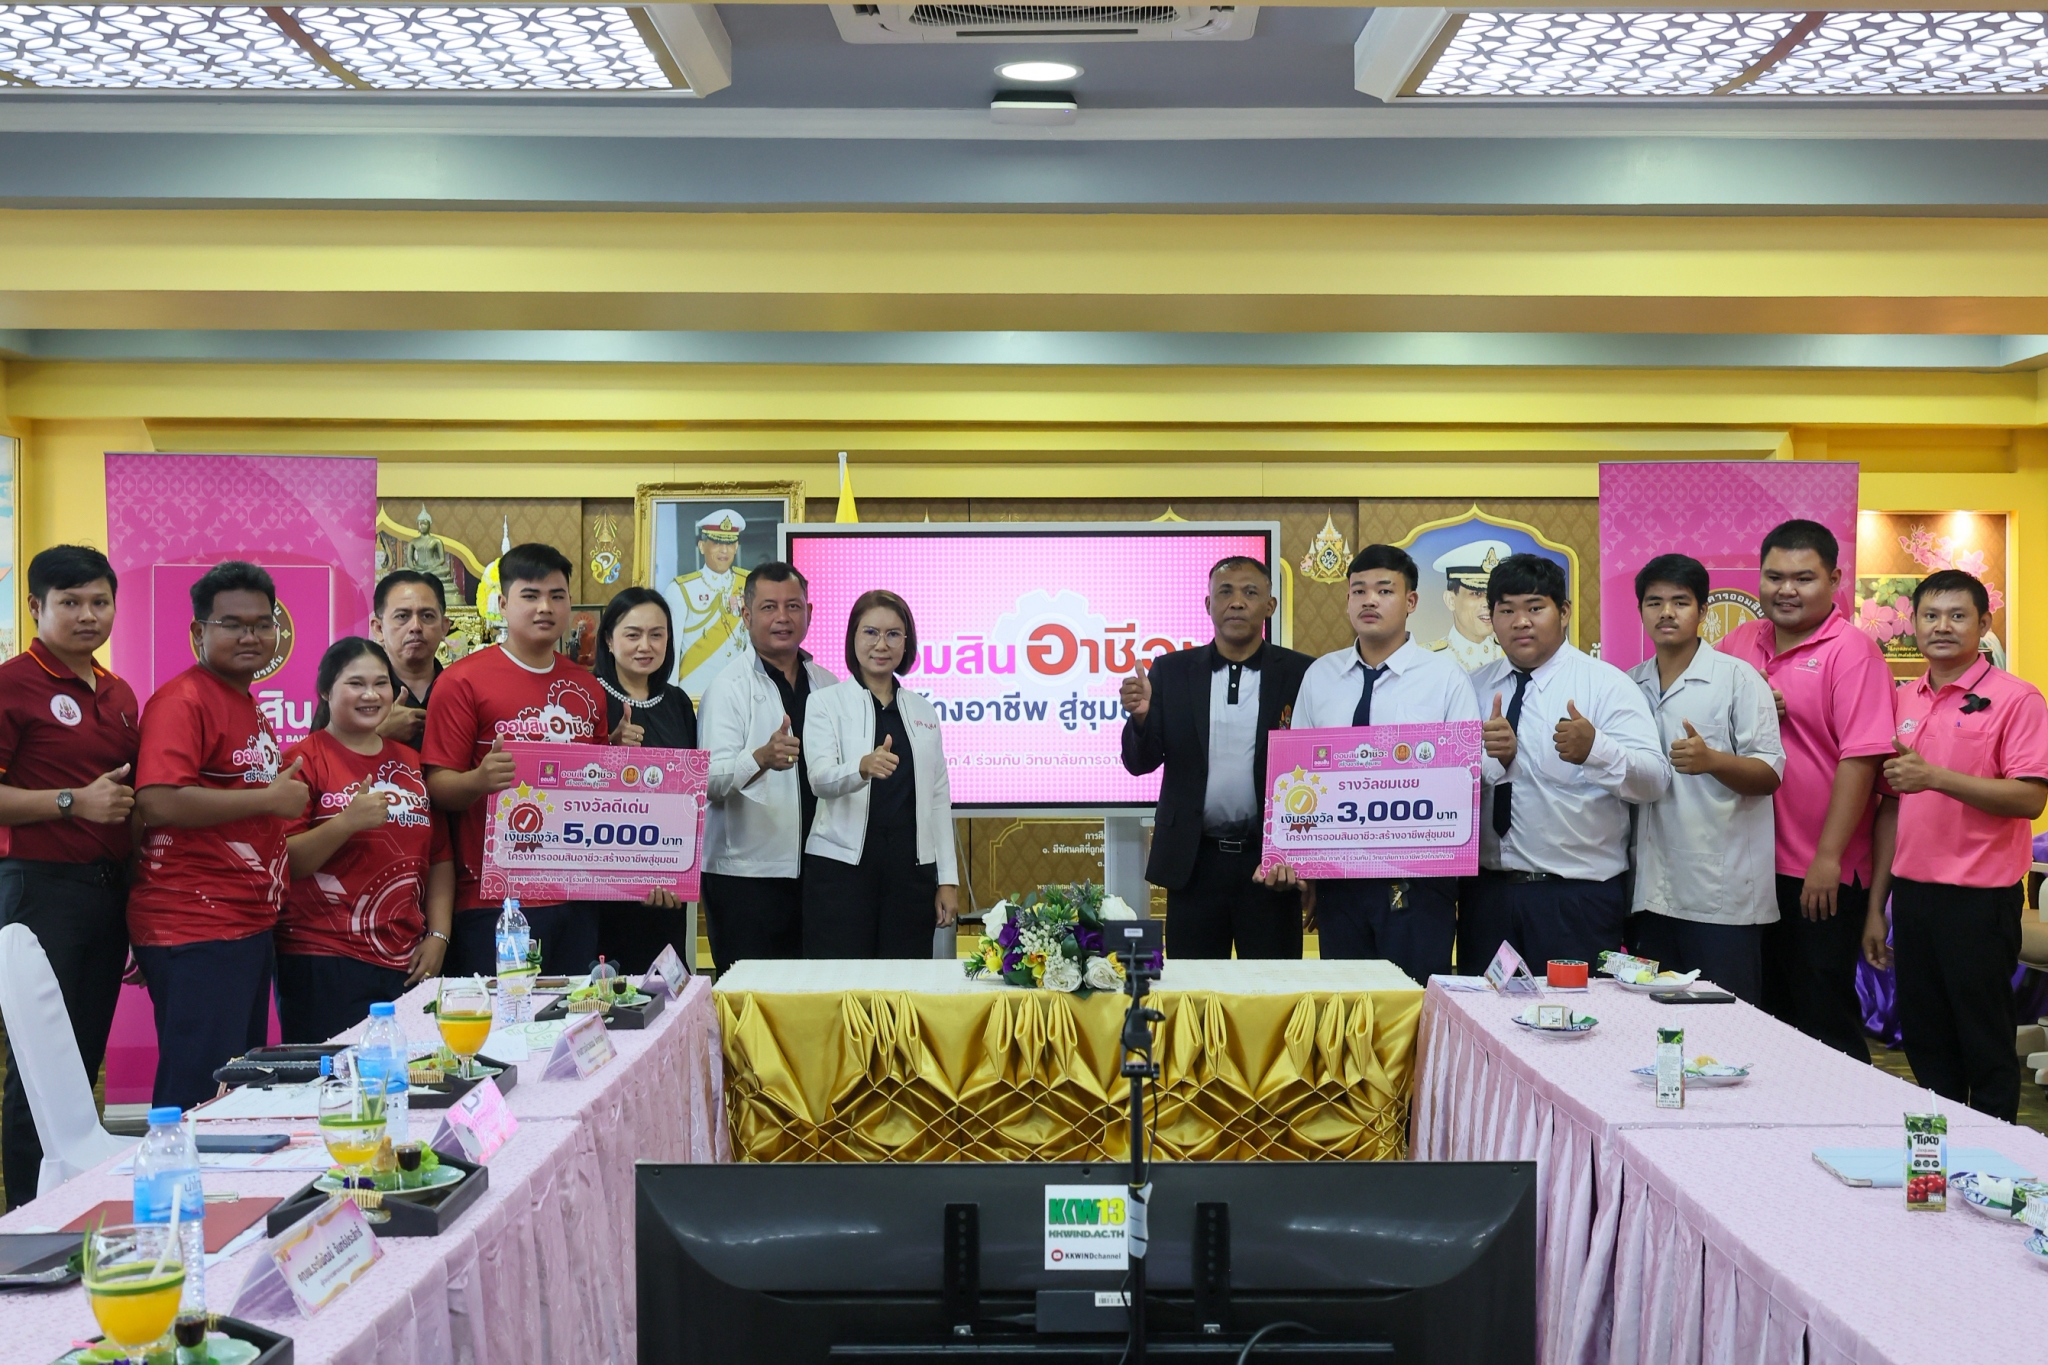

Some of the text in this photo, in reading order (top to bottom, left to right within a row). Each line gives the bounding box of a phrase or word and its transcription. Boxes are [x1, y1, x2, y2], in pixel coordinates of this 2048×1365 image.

[1707, 593, 1765, 617] คารออมสิน
[286, 734, 309, 743] BAN
[963, 755, 971, 765] 4
[976, 753, 1020, 766] ร่วมกับ
[1338, 777, 1420, 791] รางวัลชมเชย
[563, 798, 649, 814] รางวัลดีเด่น
[1281, 799, 1458, 825] เงินรางวัล 3,000 บาท
[504, 822, 683, 848] เงินรางวัล 5,000 บาท
[1285, 830, 1455, 843] โครงการออมสินอาชีวะสร้างอาชีพสู่ชุมชน
[507, 851, 679, 867] โครงการออมสินอาชีวะสร้างอาชีพสู่ชุมชน
[1065, 1252, 1121, 1260] KKWINDchannel
